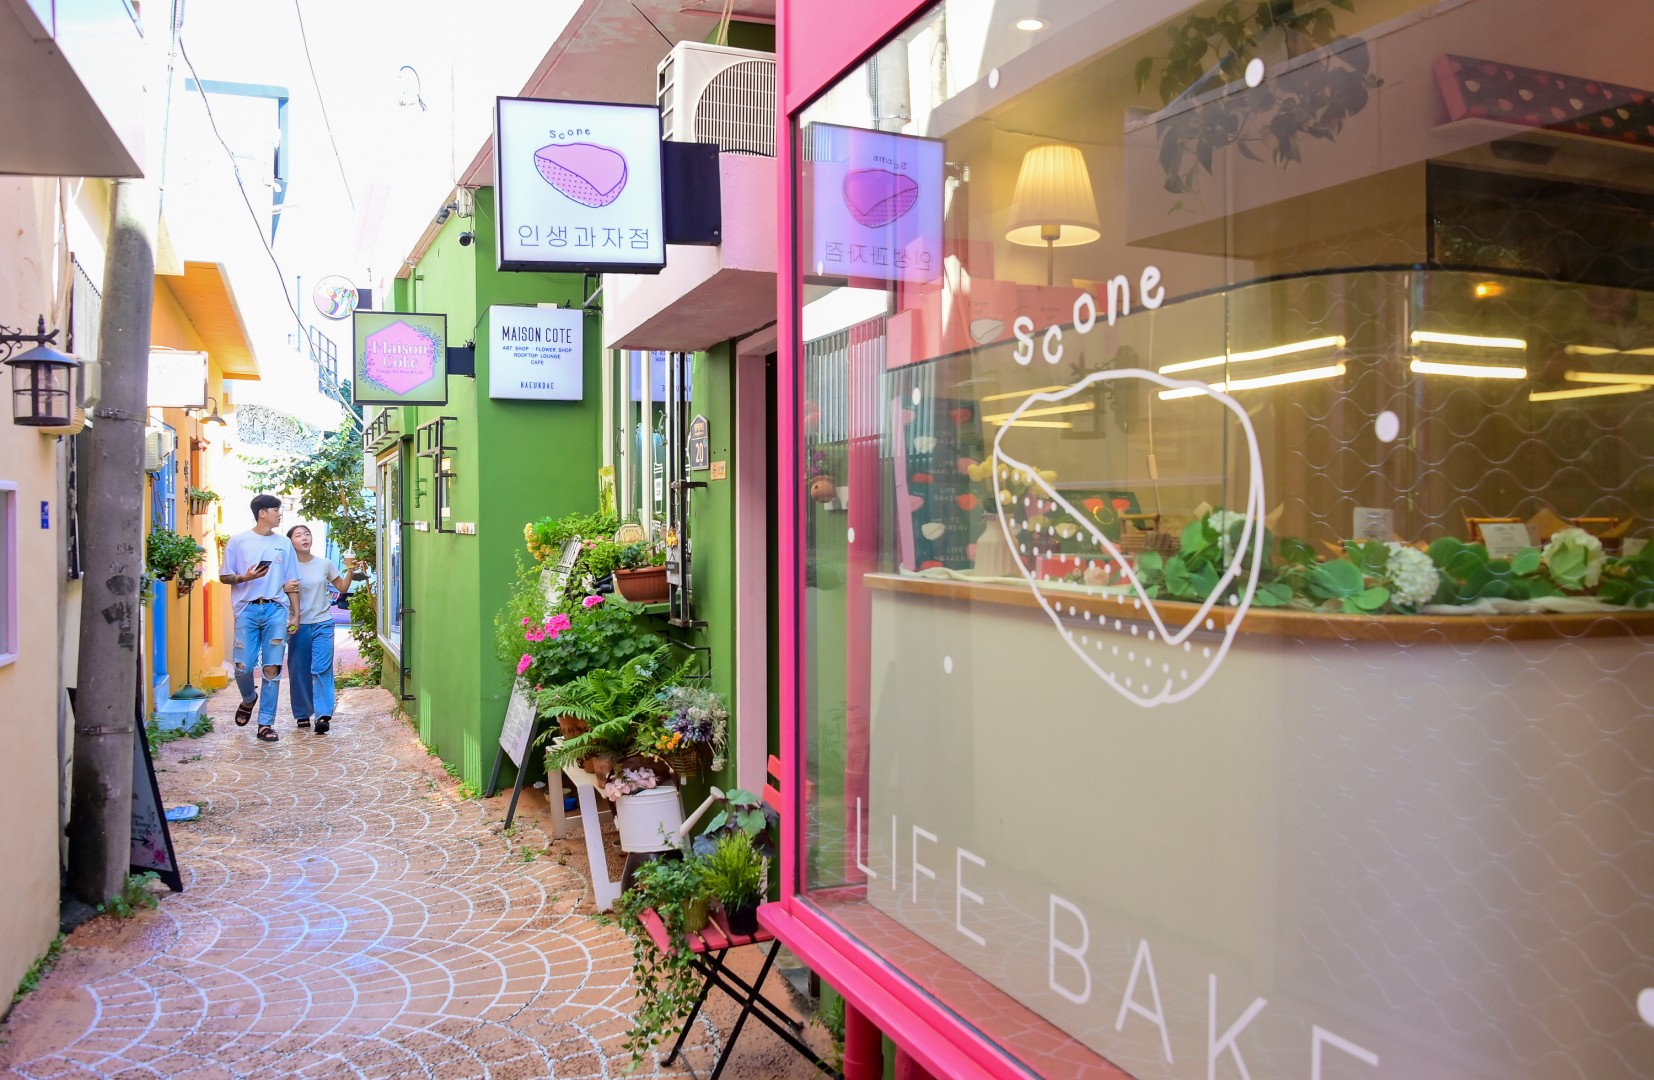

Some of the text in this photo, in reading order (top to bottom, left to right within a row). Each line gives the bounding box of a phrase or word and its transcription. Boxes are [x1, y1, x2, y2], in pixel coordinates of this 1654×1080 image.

[518, 225, 649, 249] 인생과자점
[502, 326, 572, 343] MAISON COTE
[372, 341, 428, 354] Maison
[520, 381, 554, 389] HAEUNDAE
[695, 442, 704, 462] 20
[857, 797, 986, 947] LIFE
